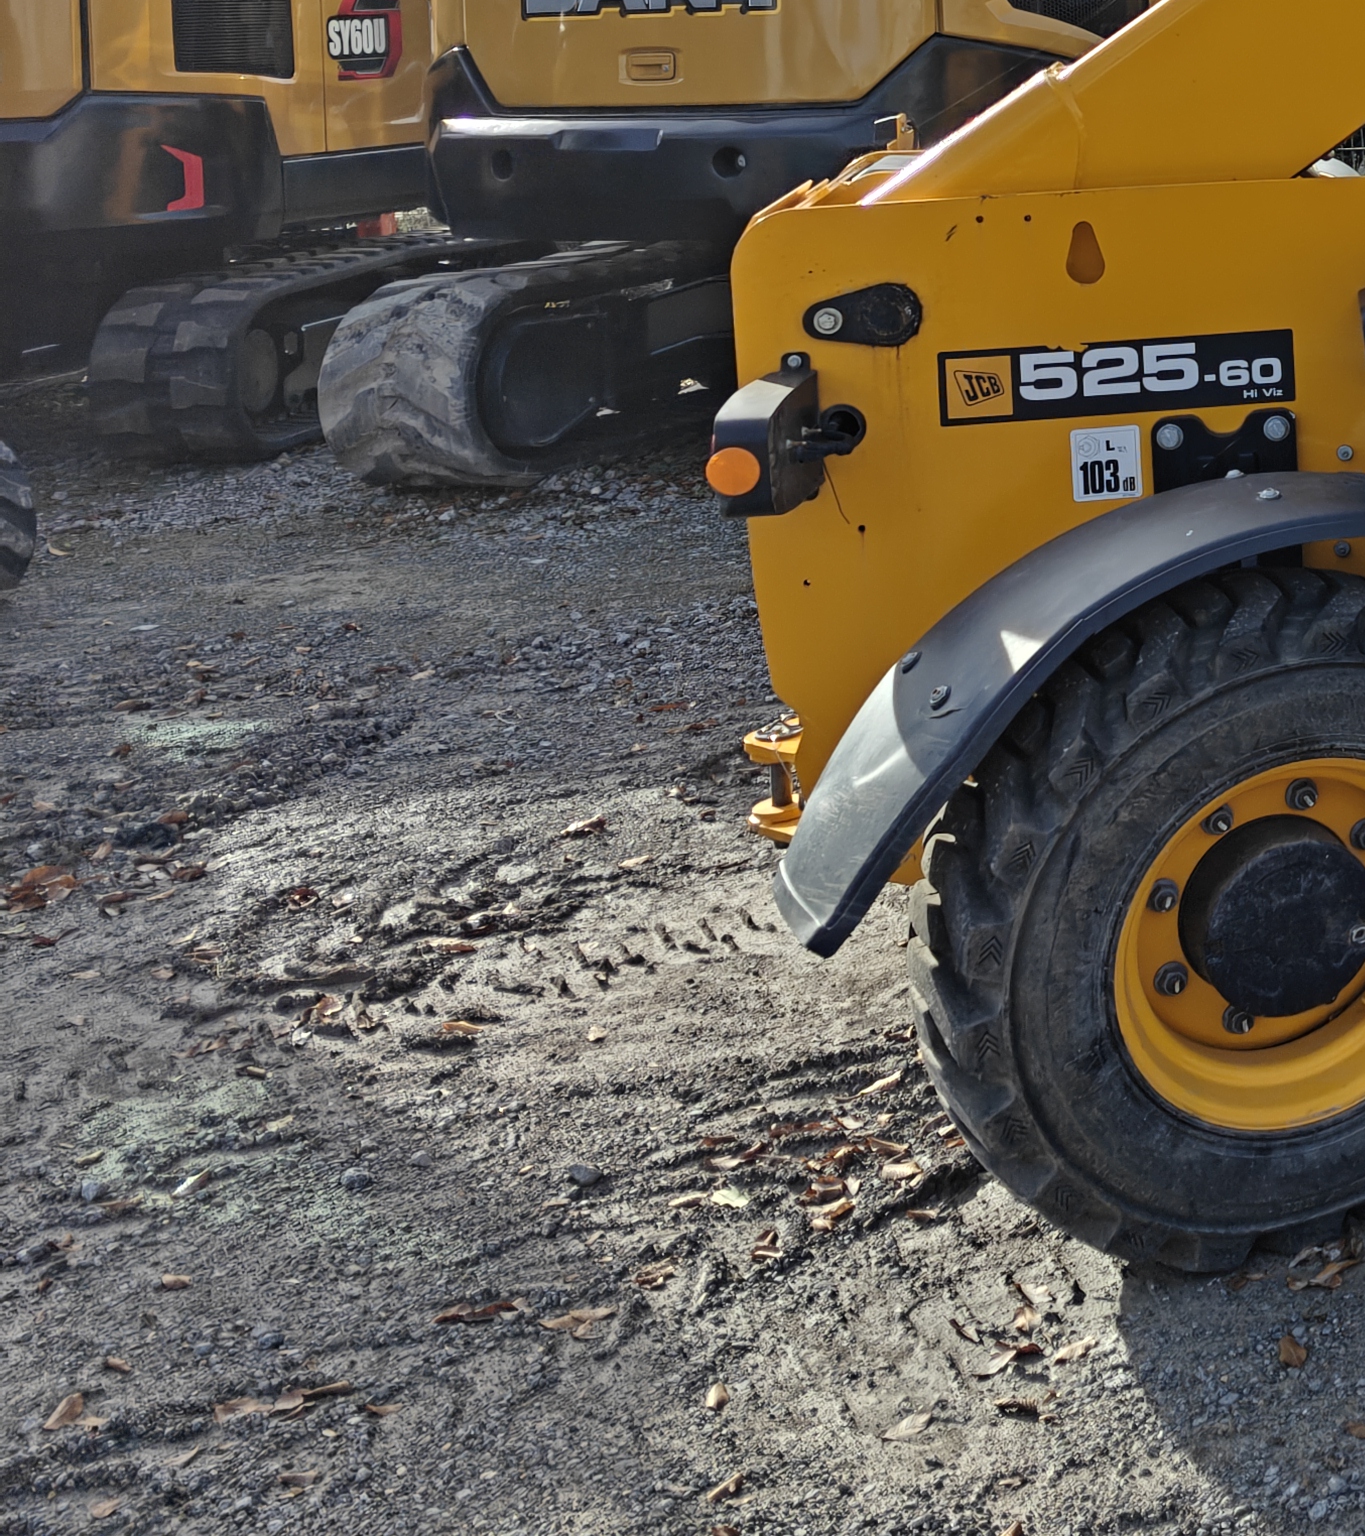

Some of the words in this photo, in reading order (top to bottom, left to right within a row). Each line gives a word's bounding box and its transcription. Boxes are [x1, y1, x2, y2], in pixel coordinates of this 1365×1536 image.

[328, 17, 387, 56] SY60U
[962, 374, 1003, 402] JCB
[1018, 342, 1283, 401] 525-60
[1243, 389, 1259, 399] Hi
[1262, 387, 1284, 397] Viz
[1079, 459, 1120, 495] 103
[1122, 476, 1136, 492] dB
